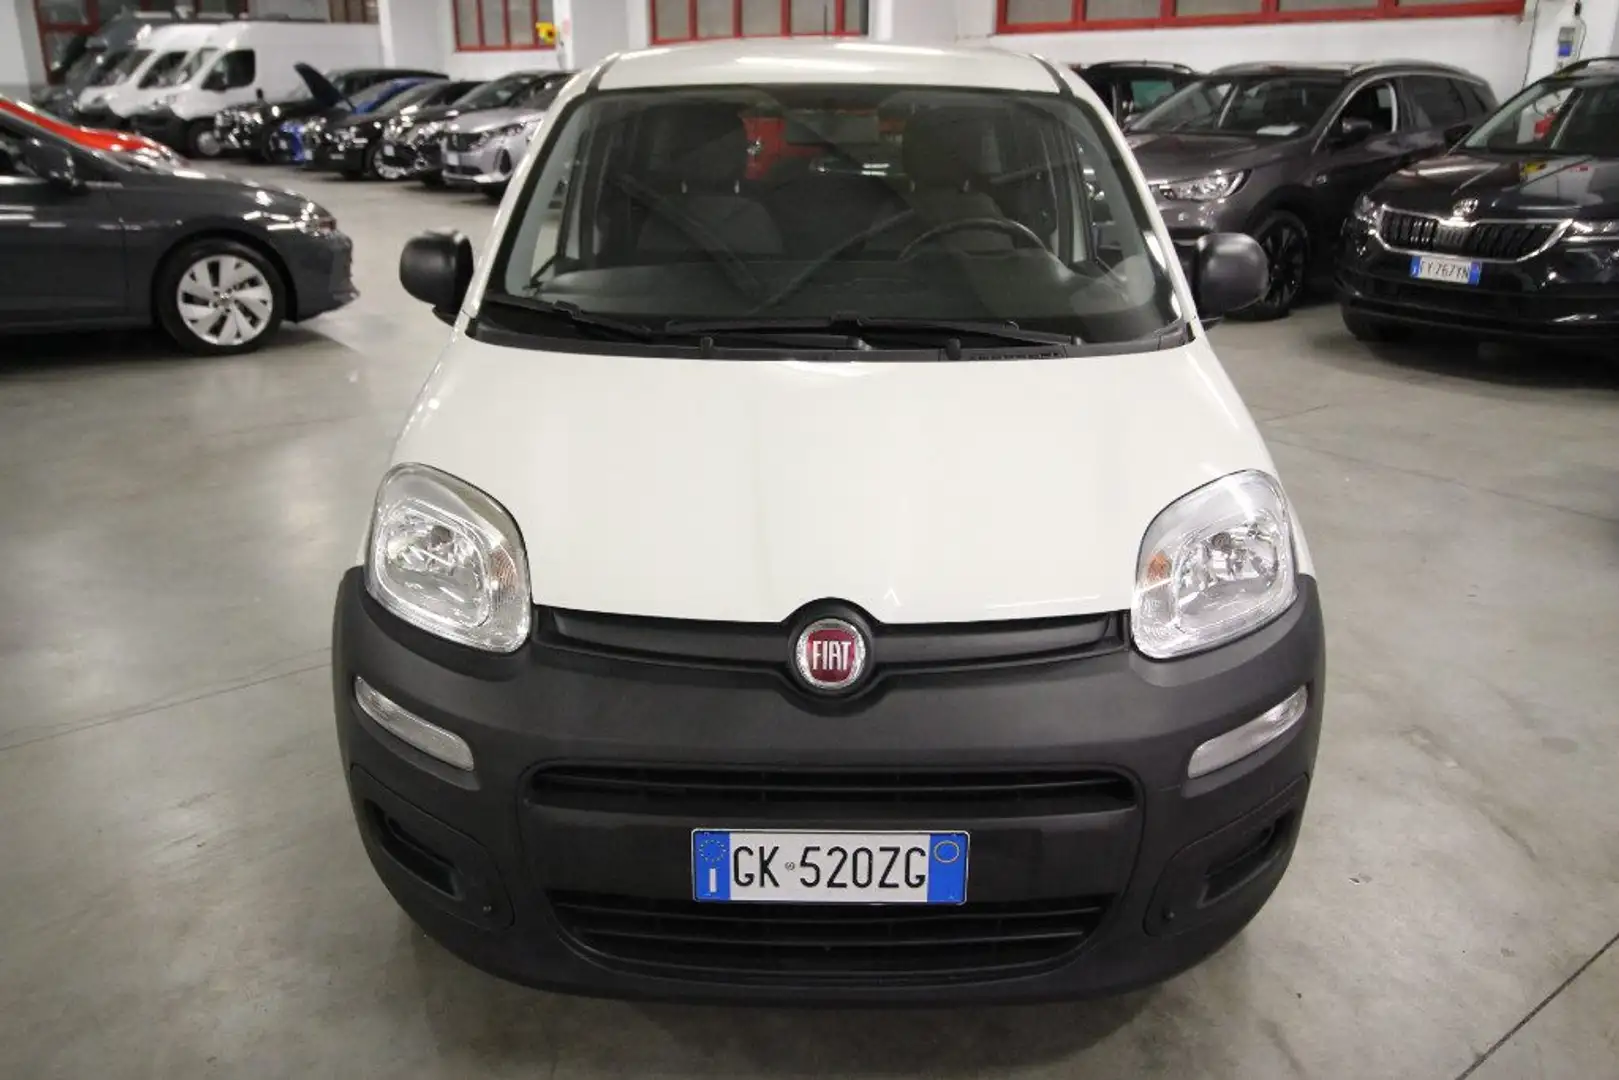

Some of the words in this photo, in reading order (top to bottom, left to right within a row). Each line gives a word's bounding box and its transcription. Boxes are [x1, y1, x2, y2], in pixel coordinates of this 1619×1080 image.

[812, 640, 851, 670] FIAT
[733, 846, 780, 888] GK
[799, 846, 927, 889] 520ZG
